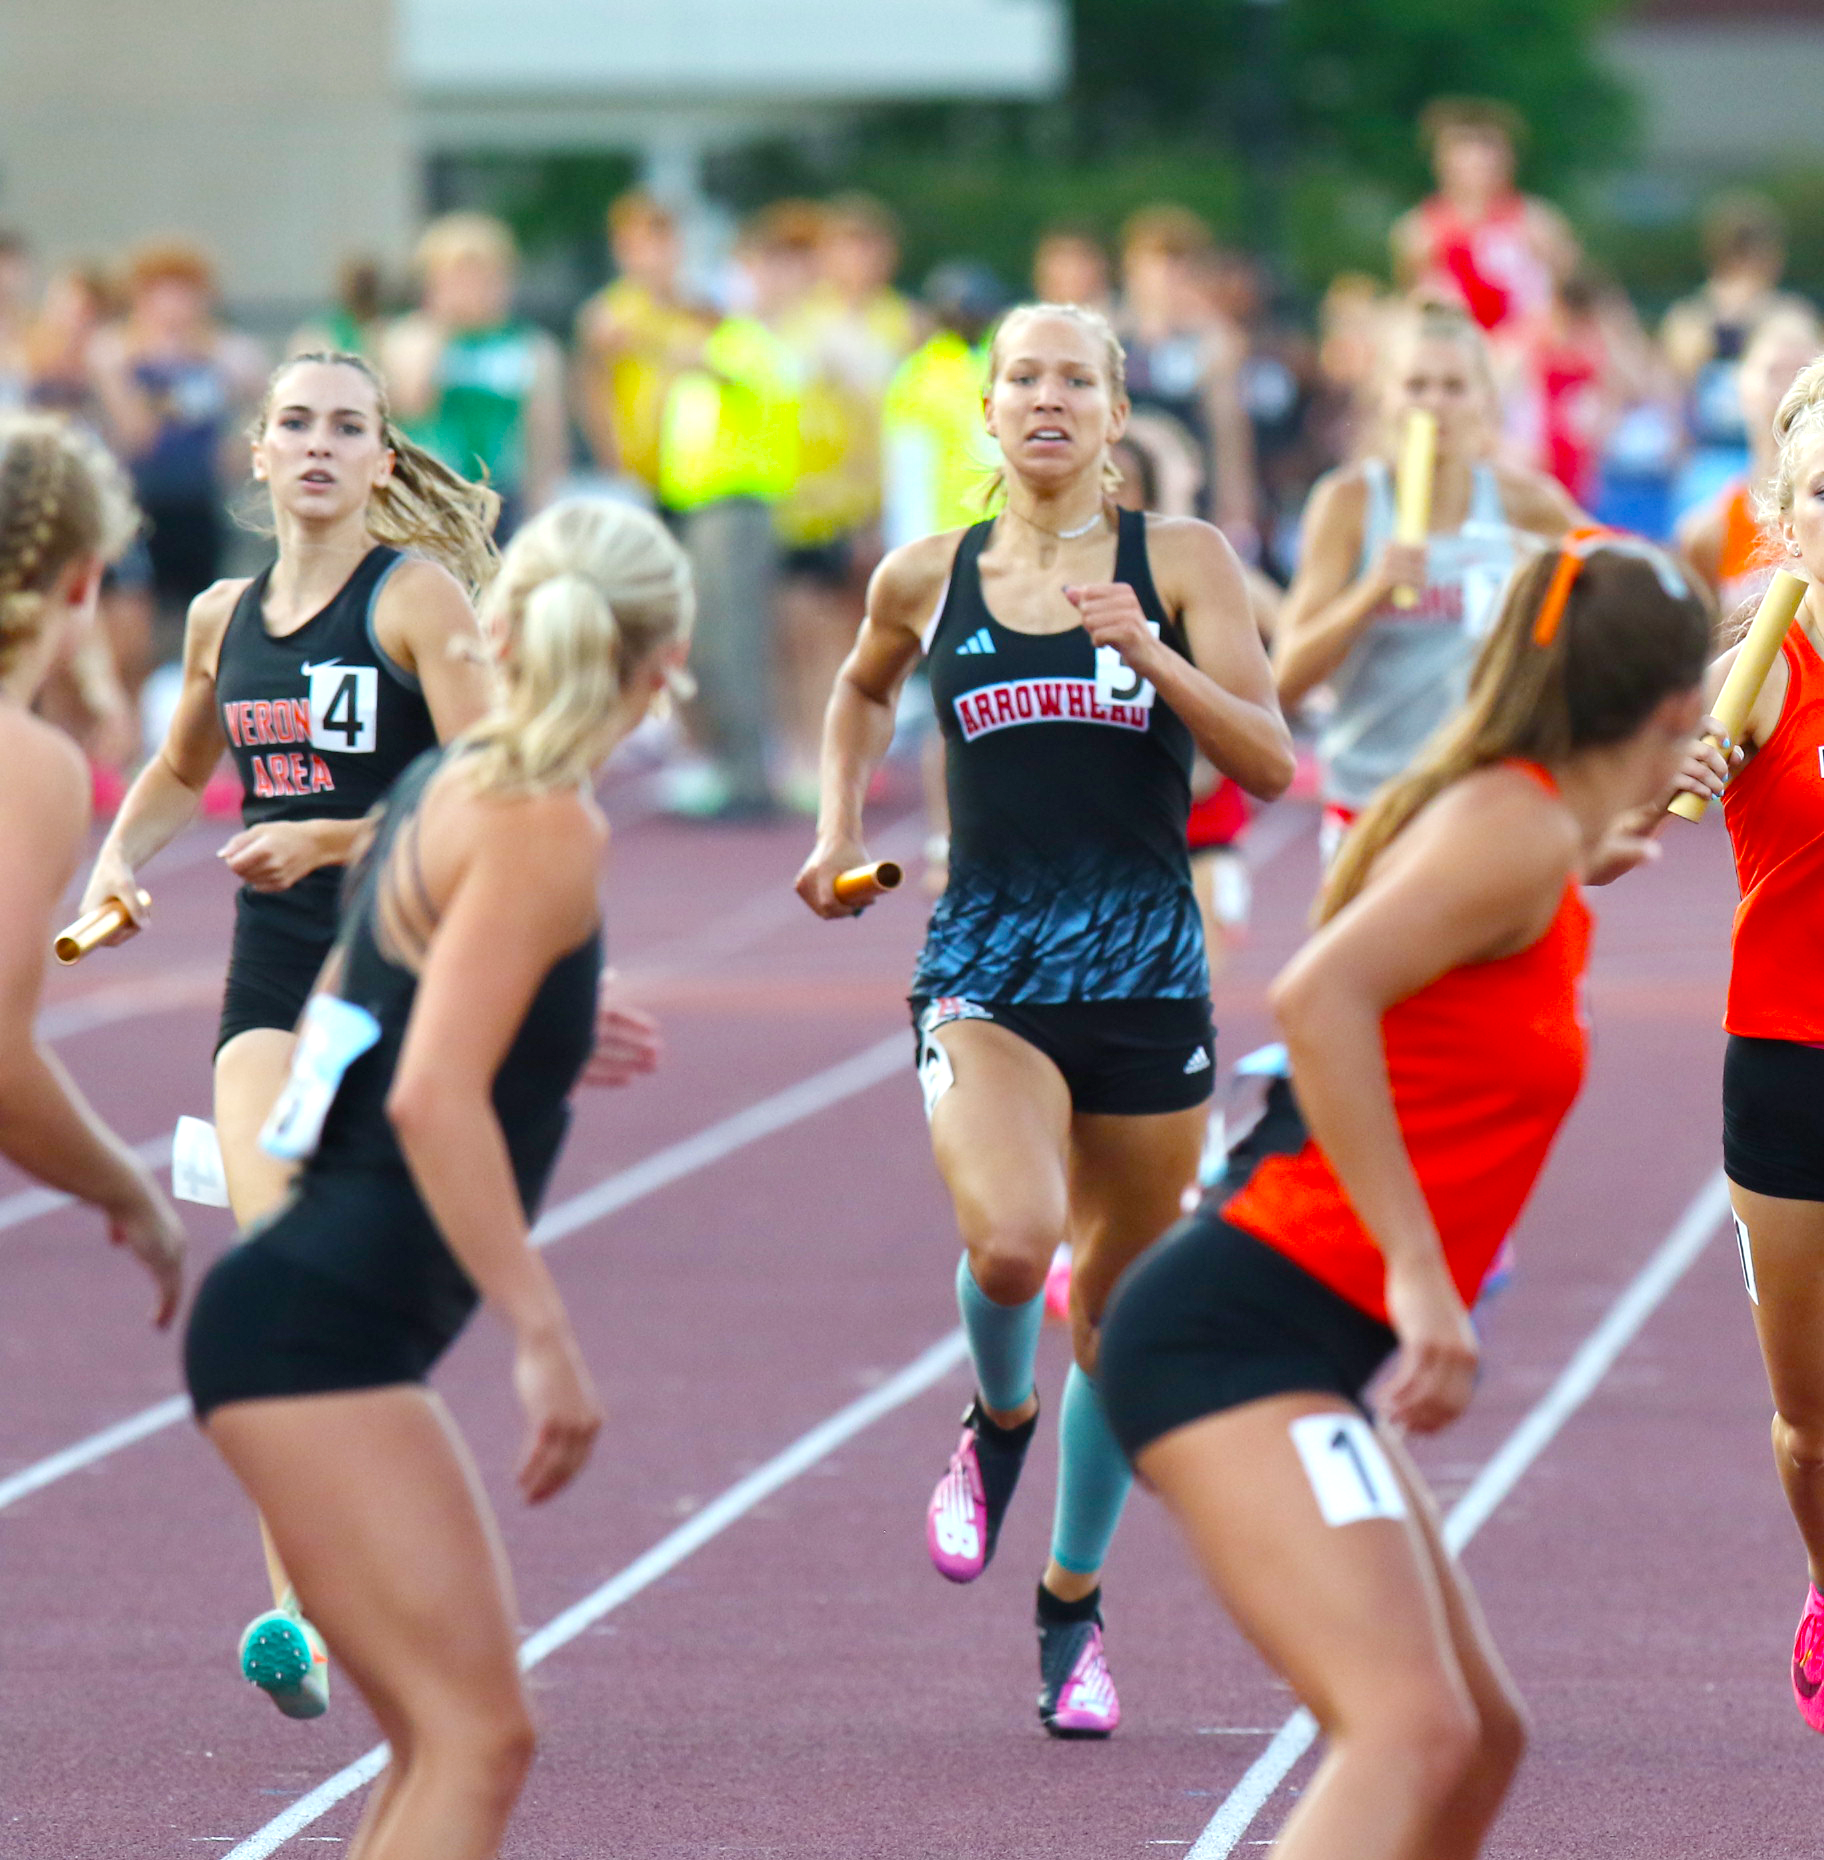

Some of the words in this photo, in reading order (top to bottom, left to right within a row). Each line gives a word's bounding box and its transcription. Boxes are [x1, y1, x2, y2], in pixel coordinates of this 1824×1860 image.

[223, 697, 312, 747] VERON
[323, 674, 364, 746] 4
[251, 752, 335, 798] AREA
[1331, 1429, 1379, 1503] 1
